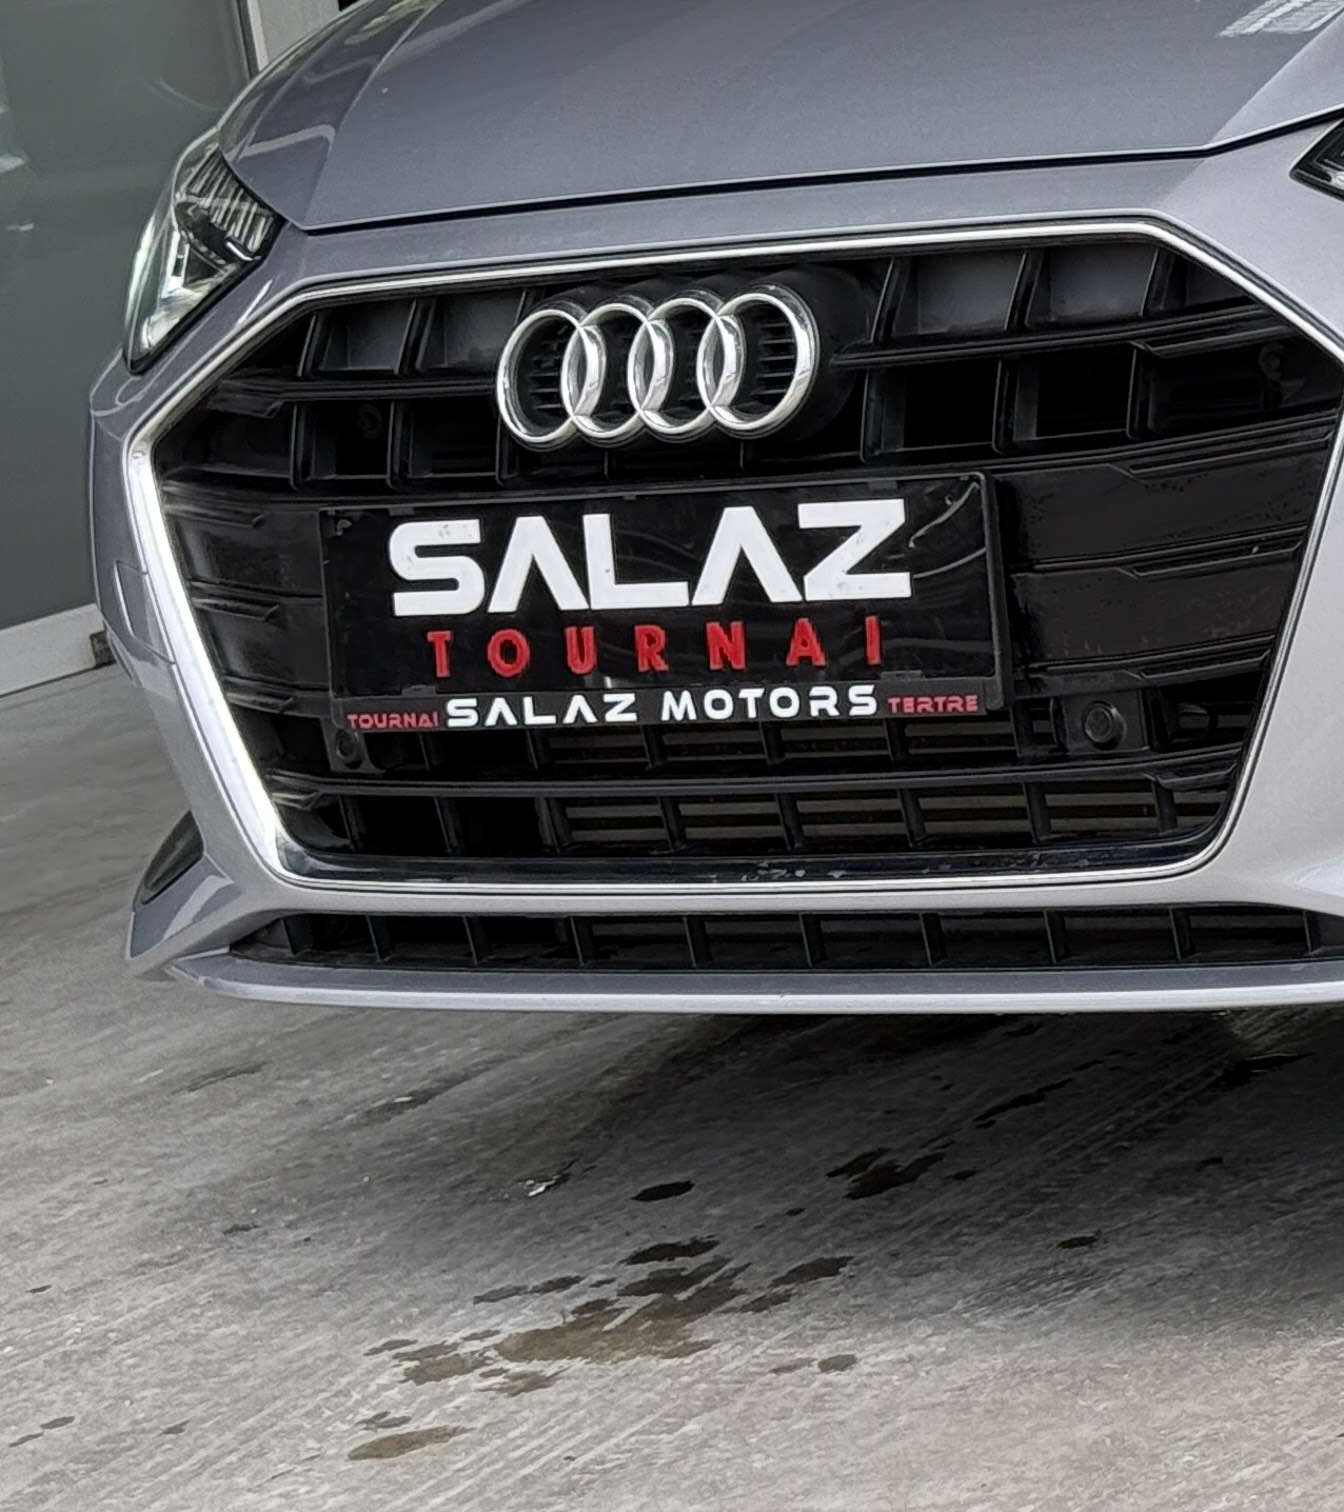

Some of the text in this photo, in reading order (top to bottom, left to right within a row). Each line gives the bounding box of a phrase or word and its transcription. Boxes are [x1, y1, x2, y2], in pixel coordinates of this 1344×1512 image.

[387, 497, 913, 617] SALAZ
[425, 615, 882, 678] TOURNAI
[346, 684, 979, 730] TOURNAI SALAZ MOTORS TERTRE
